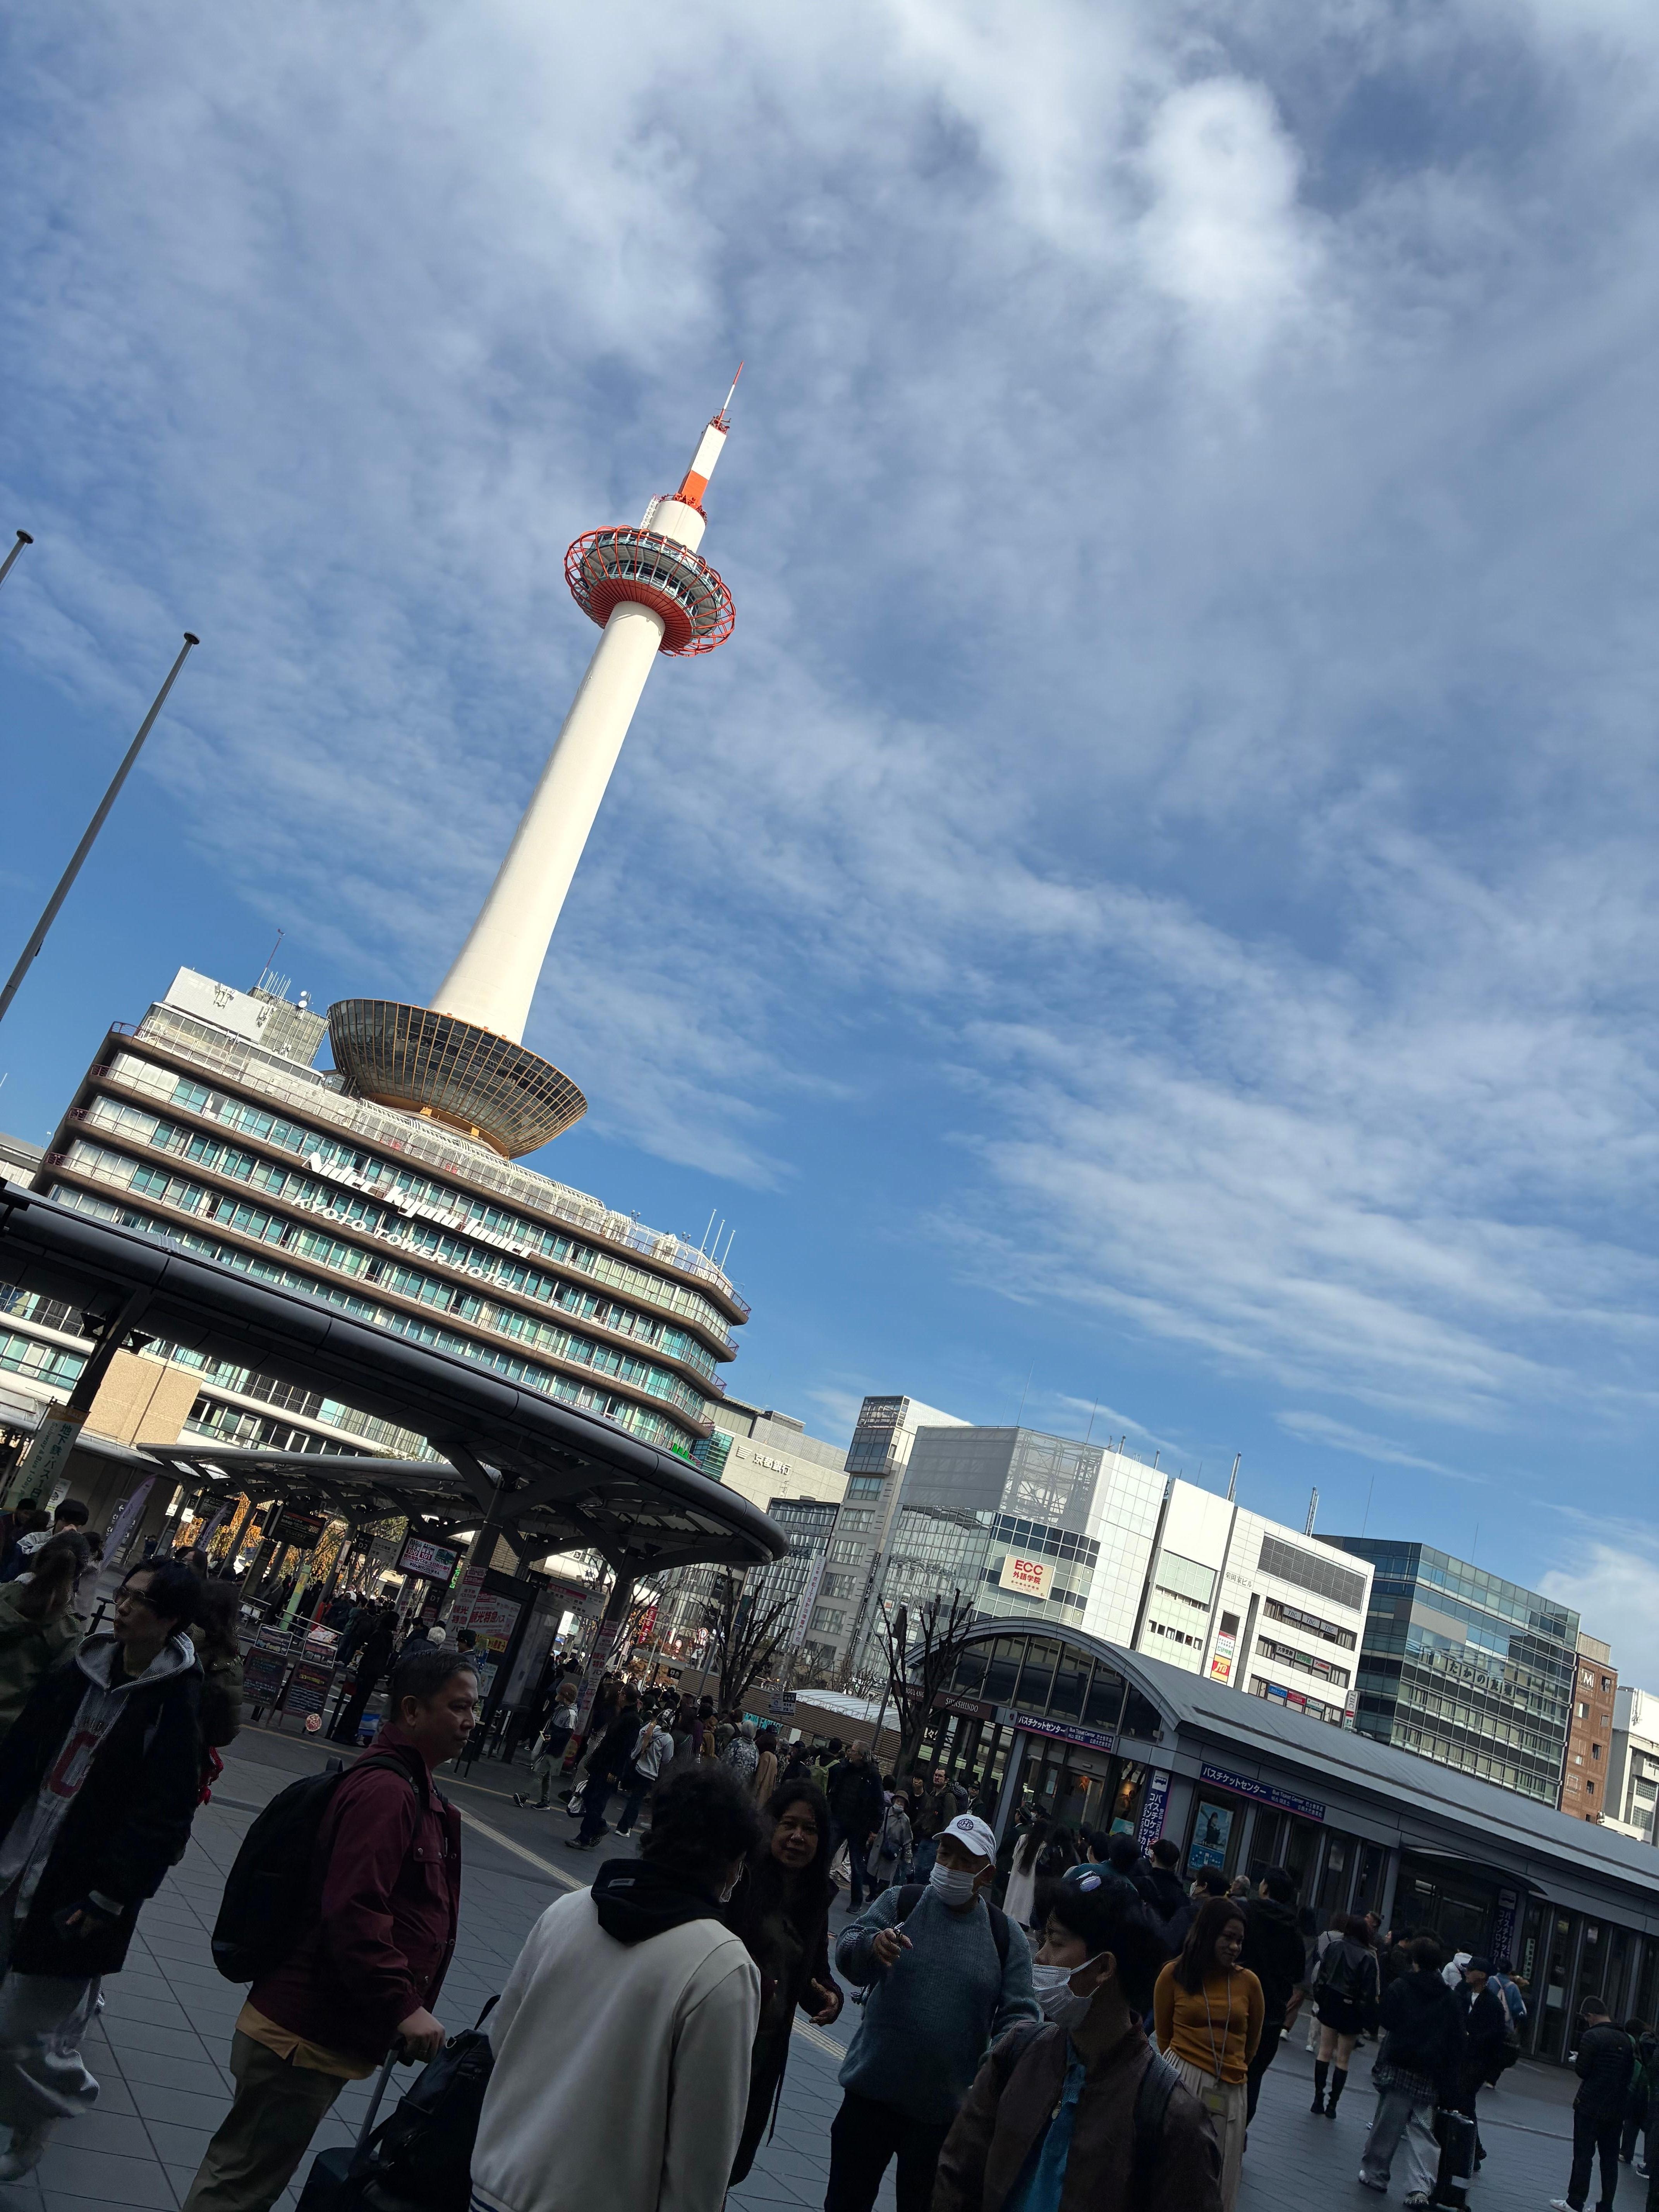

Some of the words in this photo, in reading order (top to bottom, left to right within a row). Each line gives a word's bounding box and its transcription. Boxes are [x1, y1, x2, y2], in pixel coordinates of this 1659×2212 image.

[302, 1152, 375, 1196] Nidec
[383, 1184, 460, 1230] Kyoto
[459, 1216, 540, 1259] Tower
[291, 1195, 367, 1232] KYOTO
[374, 1227, 448, 1265] TOWER
[452, 1259, 519, 1293] HOTEL
[753, 1453, 792, 1475] 京都銀行
[358, 1542, 368, 1551] D2
[1015, 1559, 1043, 1575] ECC
[1013, 1571, 1041, 1584] 外語学院
[1324, 1625, 1334, 1633] TBC
[1278, 1646, 1293, 1656] 大学受験
[1214, 1662, 1228, 1673] JTB
[1348, 1693, 1357, 1710] TBC
[1018, 1716, 1066, 1733] バスチケットセンター
[1203, 1767, 1267, 1795] バスチケットセンター
[1140, 1793, 1156, 1852] コインロッカー
